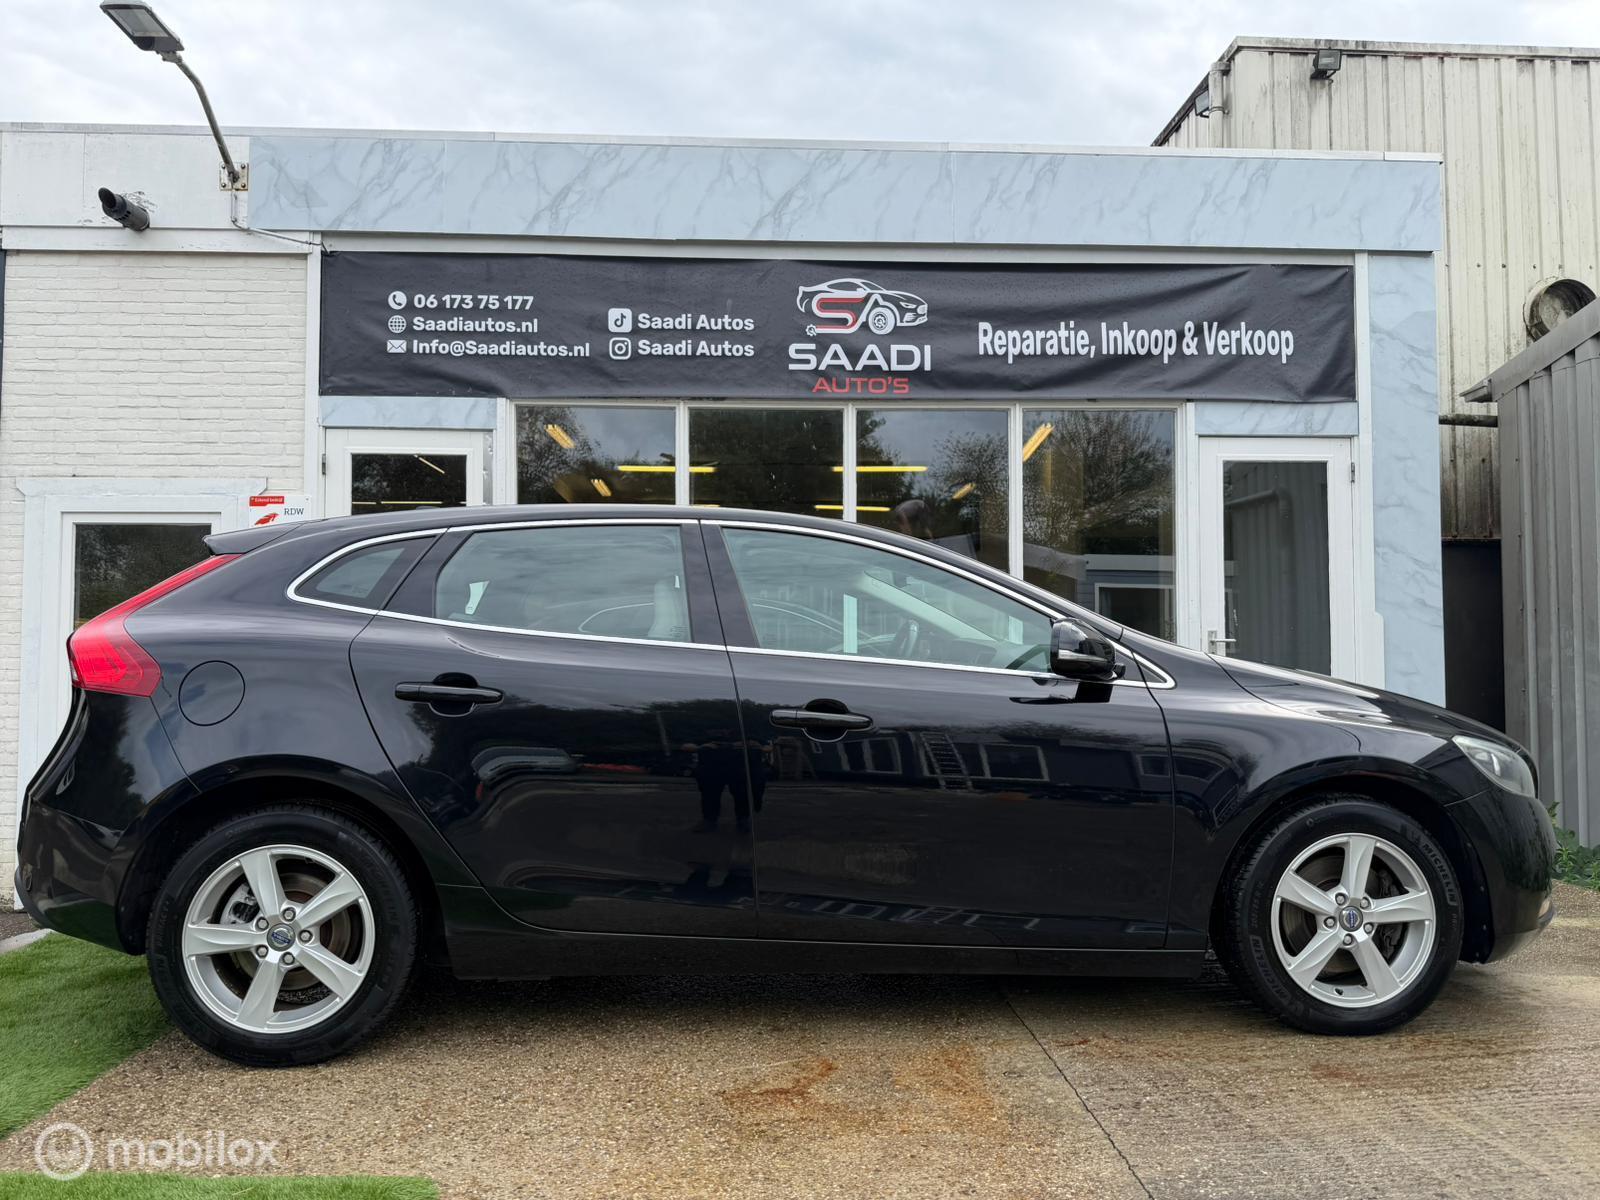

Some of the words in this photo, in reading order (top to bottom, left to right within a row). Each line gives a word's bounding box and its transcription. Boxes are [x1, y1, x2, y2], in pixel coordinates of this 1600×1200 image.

[412, 293, 438, 309] 06
[441, 294, 474, 310] 173
[476, 294, 500, 310] 75
[502, 295, 535, 311] 177
[412, 316, 539, 334] Saadiautos.nl
[637, 312, 692, 331] Saadi
[695, 313, 755, 331] Autos
[412, 338, 591, 358] Info@Saadiautos.nl
[637, 338, 692, 357] Saadi
[695, 339, 755, 358] Autos
[977, 319, 1096, 365] Reparatie,
[1100, 320, 1178, 364] Inkoop
[1182, 320, 1200, 357] &
[1202, 320, 1296, 365] Verkoop
[787, 342, 933, 372] SAADI
[811, 376, 910, 394] AUTO'S
[284, 507, 304, 516] RDW
[1421, 842, 1458, 903] MICHELIN
